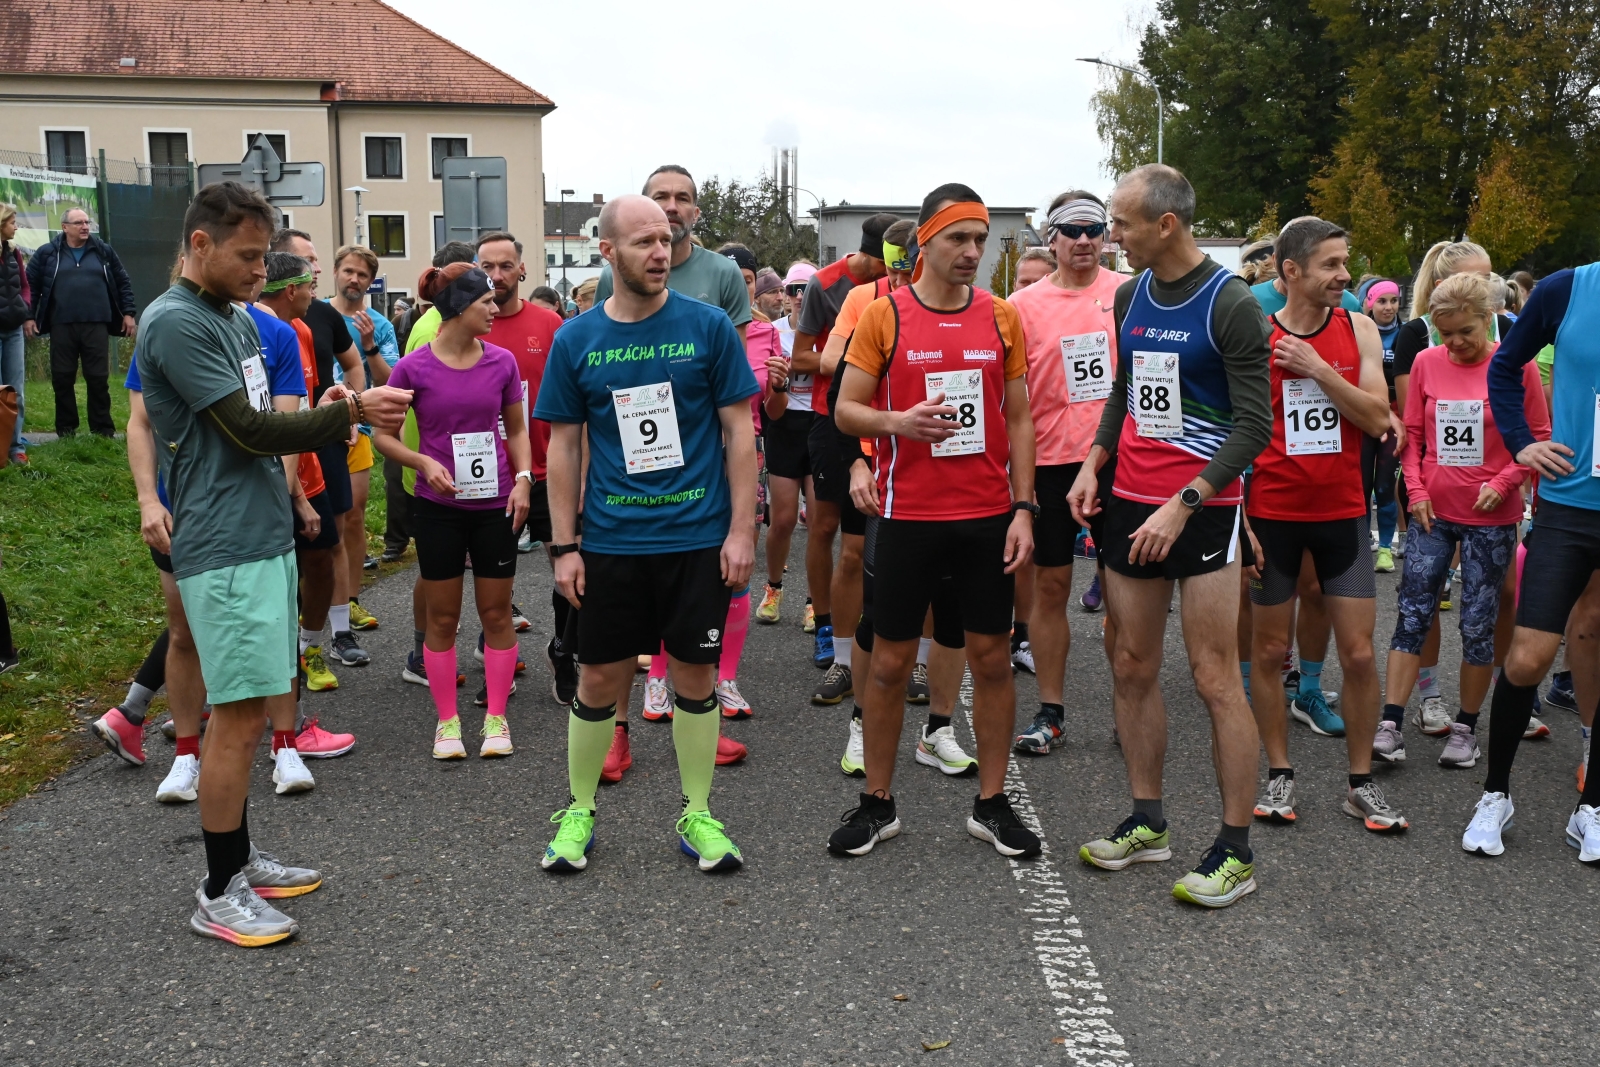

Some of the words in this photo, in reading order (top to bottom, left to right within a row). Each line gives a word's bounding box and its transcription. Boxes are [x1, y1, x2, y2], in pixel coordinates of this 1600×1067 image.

[1130, 325, 1146, 336] AK
[587, 351, 602, 367] DJ
[605, 343, 655, 364] BRÁCHA
[659, 342, 695, 358] TEAM
[1074, 358, 1104, 382] 56
[616, 397, 631, 405] CUP
[1139, 384, 1171, 412] 88
[648, 407, 670, 416] METUJE
[1287, 407, 1339, 432] 169
[639, 418, 658, 445] 9
[1444, 426, 1475, 446] 84
[471, 458, 485, 479] 6
